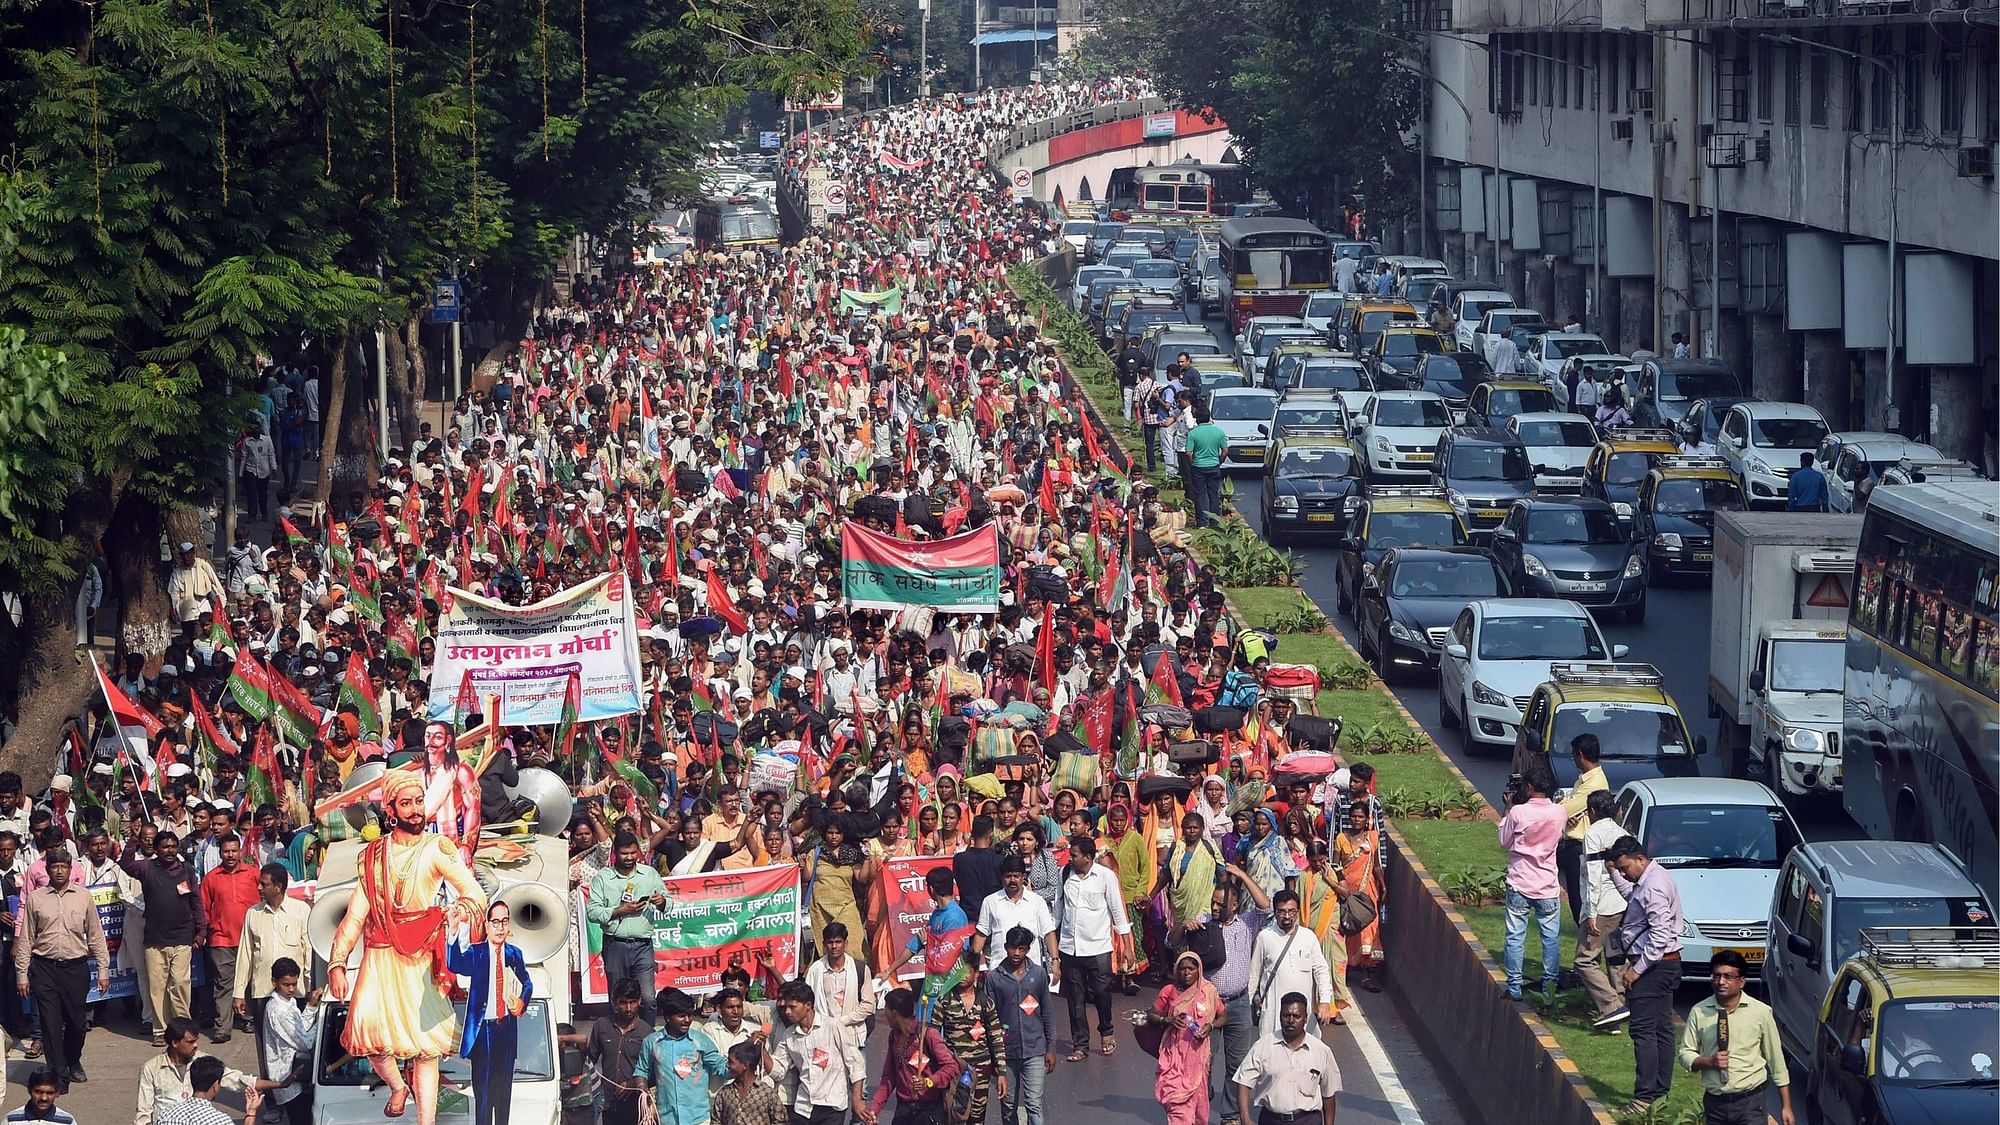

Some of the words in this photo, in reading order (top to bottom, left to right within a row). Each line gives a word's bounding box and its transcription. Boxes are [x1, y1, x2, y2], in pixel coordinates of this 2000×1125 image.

[845, 563, 885, 593] लोक
[950, 567, 994, 592] मोर्चा
[704, 917, 738, 939] चलो
[672, 947, 722, 973] संघर्ष
[673, 972, 710, 985] प्रतिभाताई
